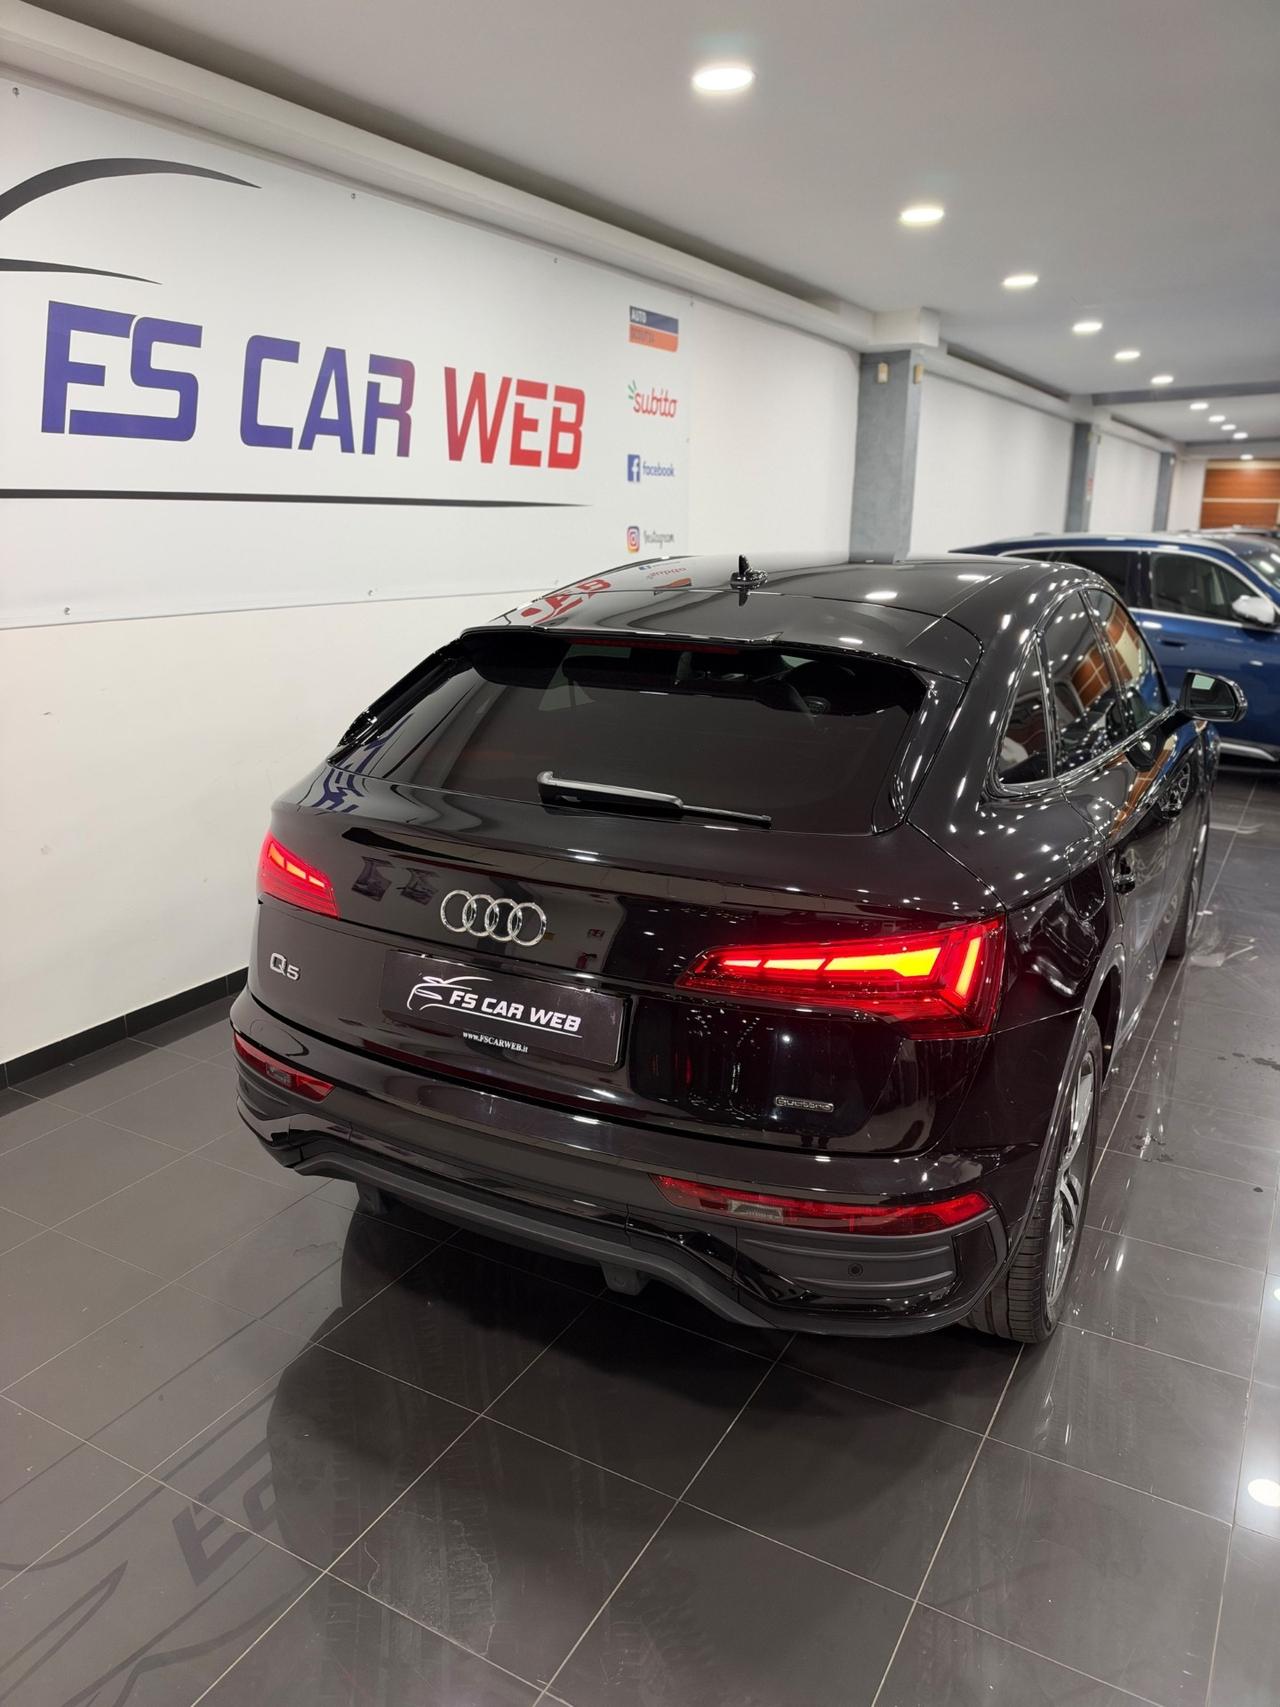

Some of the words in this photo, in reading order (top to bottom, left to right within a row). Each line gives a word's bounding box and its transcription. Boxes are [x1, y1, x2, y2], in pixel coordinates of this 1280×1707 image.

[41, 300, 203, 442] FS
[239, 334, 416, 457] CAR
[443, 366, 586, 470] WEB
[633, 387, 677, 418] subito
[642, 461, 674, 477] facebook
[270, 952, 299, 980] Q5
[449, 990, 477, 1008] FS
[481, 998, 524, 1020] CAR
[529, 1007, 582, 1032] WEB
[462, 1031, 528, 1053] www.FSCARWEB.it
